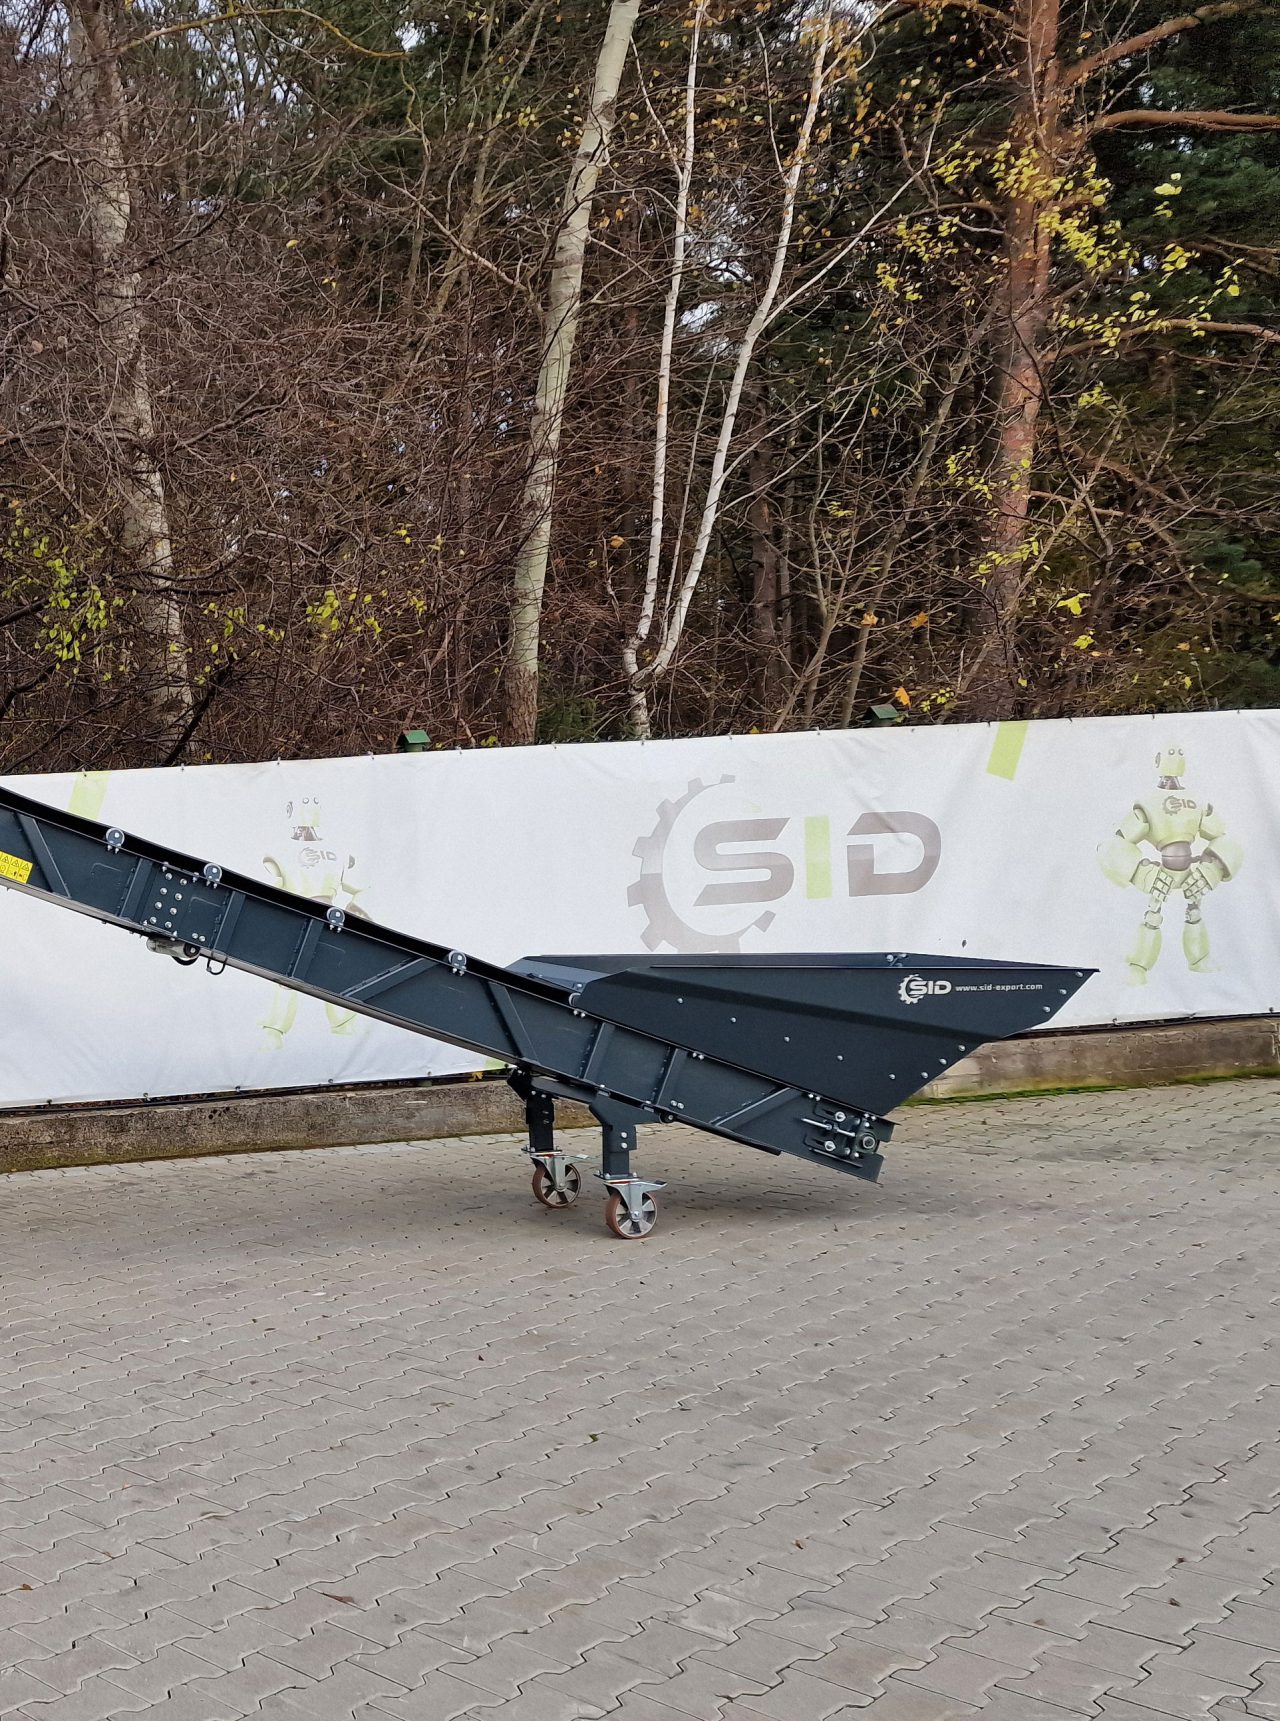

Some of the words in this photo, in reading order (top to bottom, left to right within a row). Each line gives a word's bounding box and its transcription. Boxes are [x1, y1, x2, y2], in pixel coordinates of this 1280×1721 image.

[1170, 799, 1197, 810] SID
[693, 811, 941, 906] SID
[908, 980, 952, 995] SID
[955, 983, 1043, 992] www.sid-export.com
